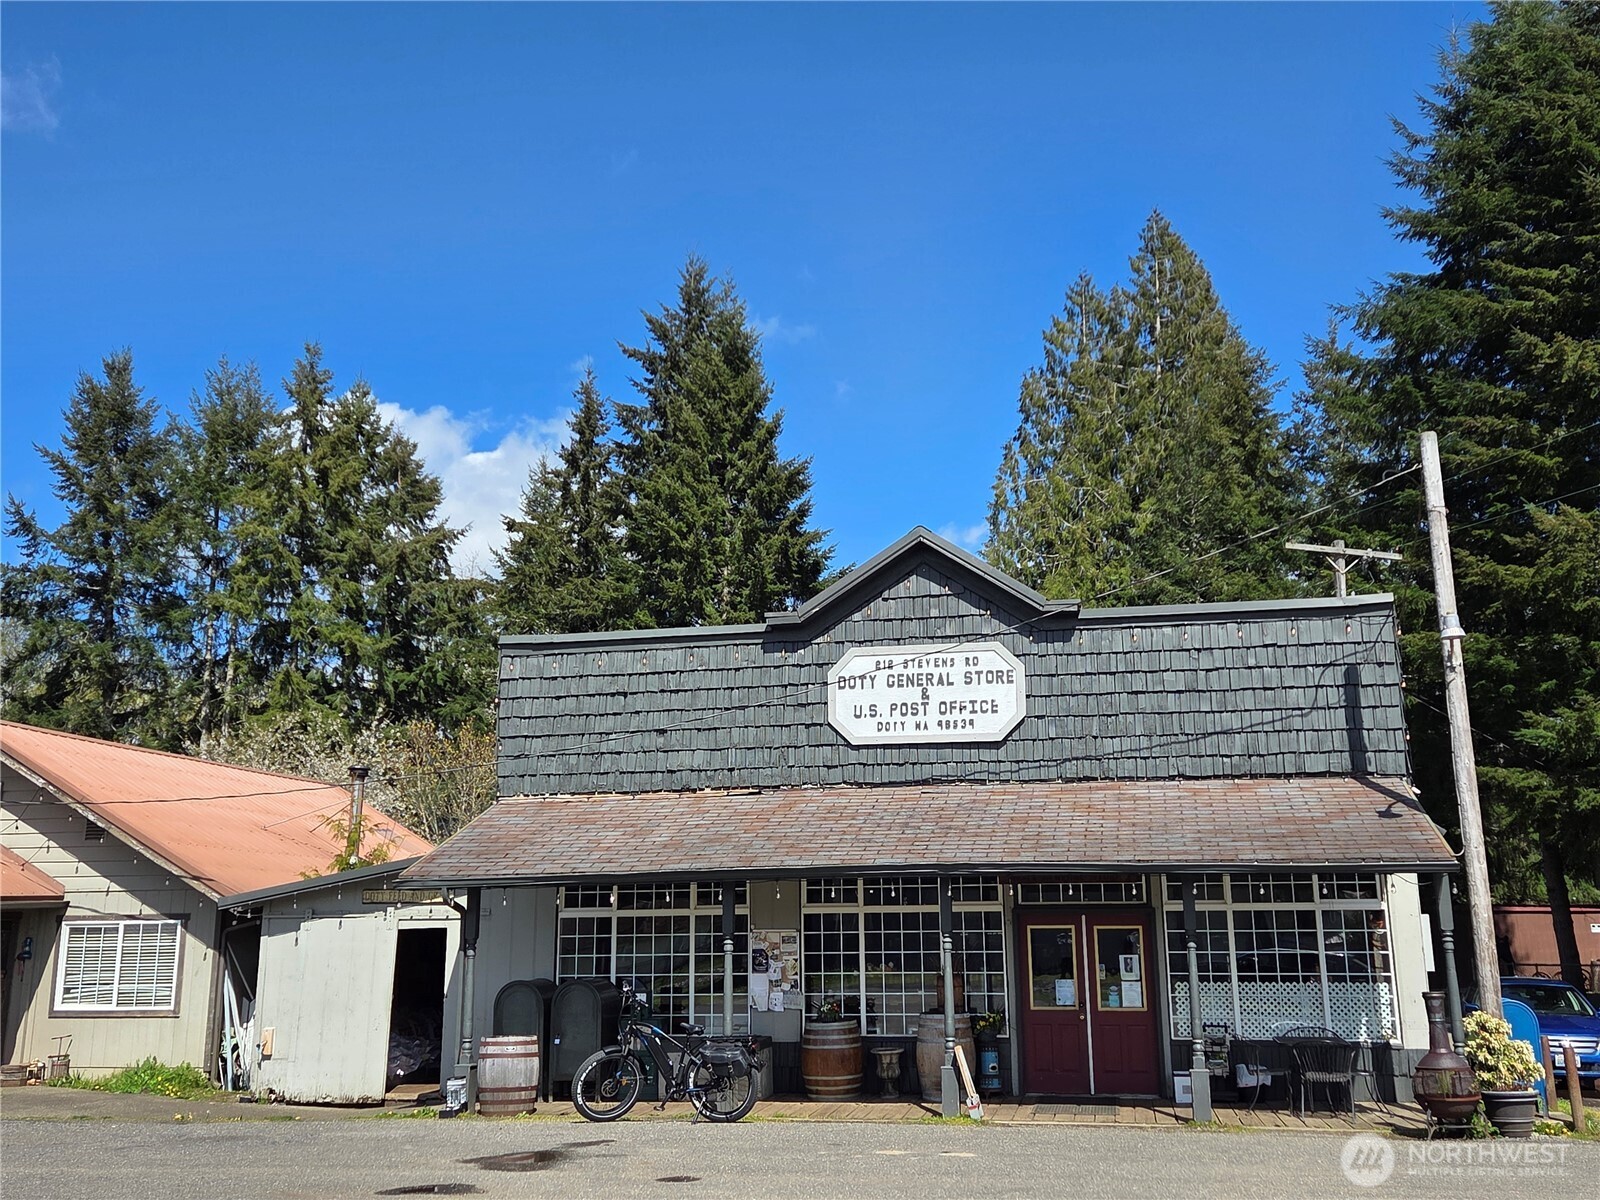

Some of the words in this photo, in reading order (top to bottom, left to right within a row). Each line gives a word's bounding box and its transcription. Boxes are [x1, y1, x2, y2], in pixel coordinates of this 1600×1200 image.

[903, 657, 955, 669] STEVENS
[964, 656, 979, 667] RD
[837, 674, 877, 690] DOTY
[887, 672, 955, 688] GENERAL
[964, 669, 1015, 685] STORE
[921, 687, 930, 700] &
[854, 703, 883, 719] U.S.
[890, 702, 930, 717] POST
[938, 699, 999, 715] OFFICE
[877, 721, 906, 732] DOTY
[937, 718, 975, 731] 98539
